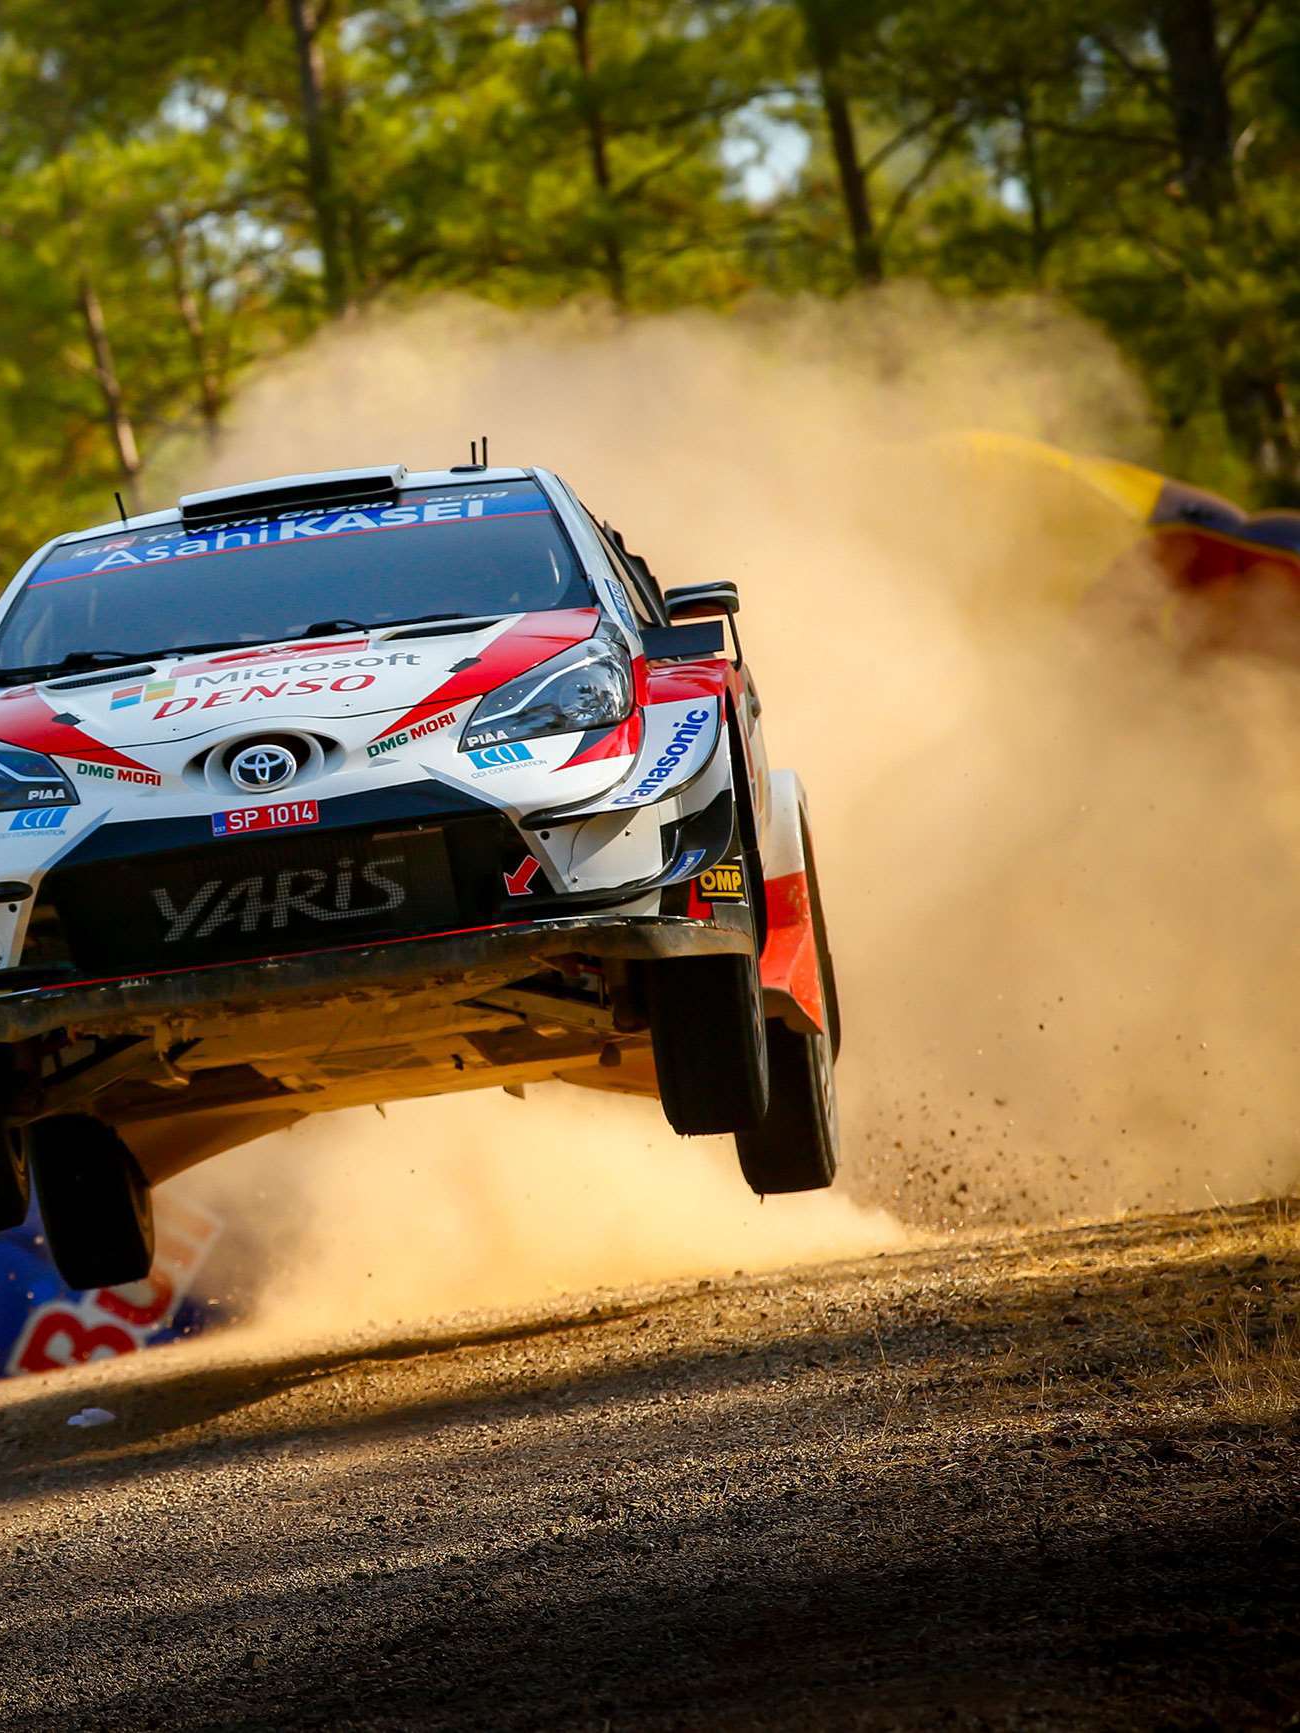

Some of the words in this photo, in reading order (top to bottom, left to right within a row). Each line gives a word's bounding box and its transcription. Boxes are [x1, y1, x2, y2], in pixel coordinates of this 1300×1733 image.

[143, 516, 268, 543] TOYOTA
[277, 501, 393, 520] GAZOO
[195, 652, 421, 688] Microsoft
[153, 674, 376, 720] DENSO
[367, 732, 409, 758] DMG
[410, 712, 457, 741] MORI
[467, 729, 508, 747] PIAA
[611, 709, 710, 804] Panasonic
[76, 762, 115, 779] DMG
[117, 769, 162, 787] MORI
[28, 788, 66, 801] PIAA
[229, 809, 259, 830] SP
[267, 803, 314, 824] 1014
[700, 869, 742, 892] OMP
